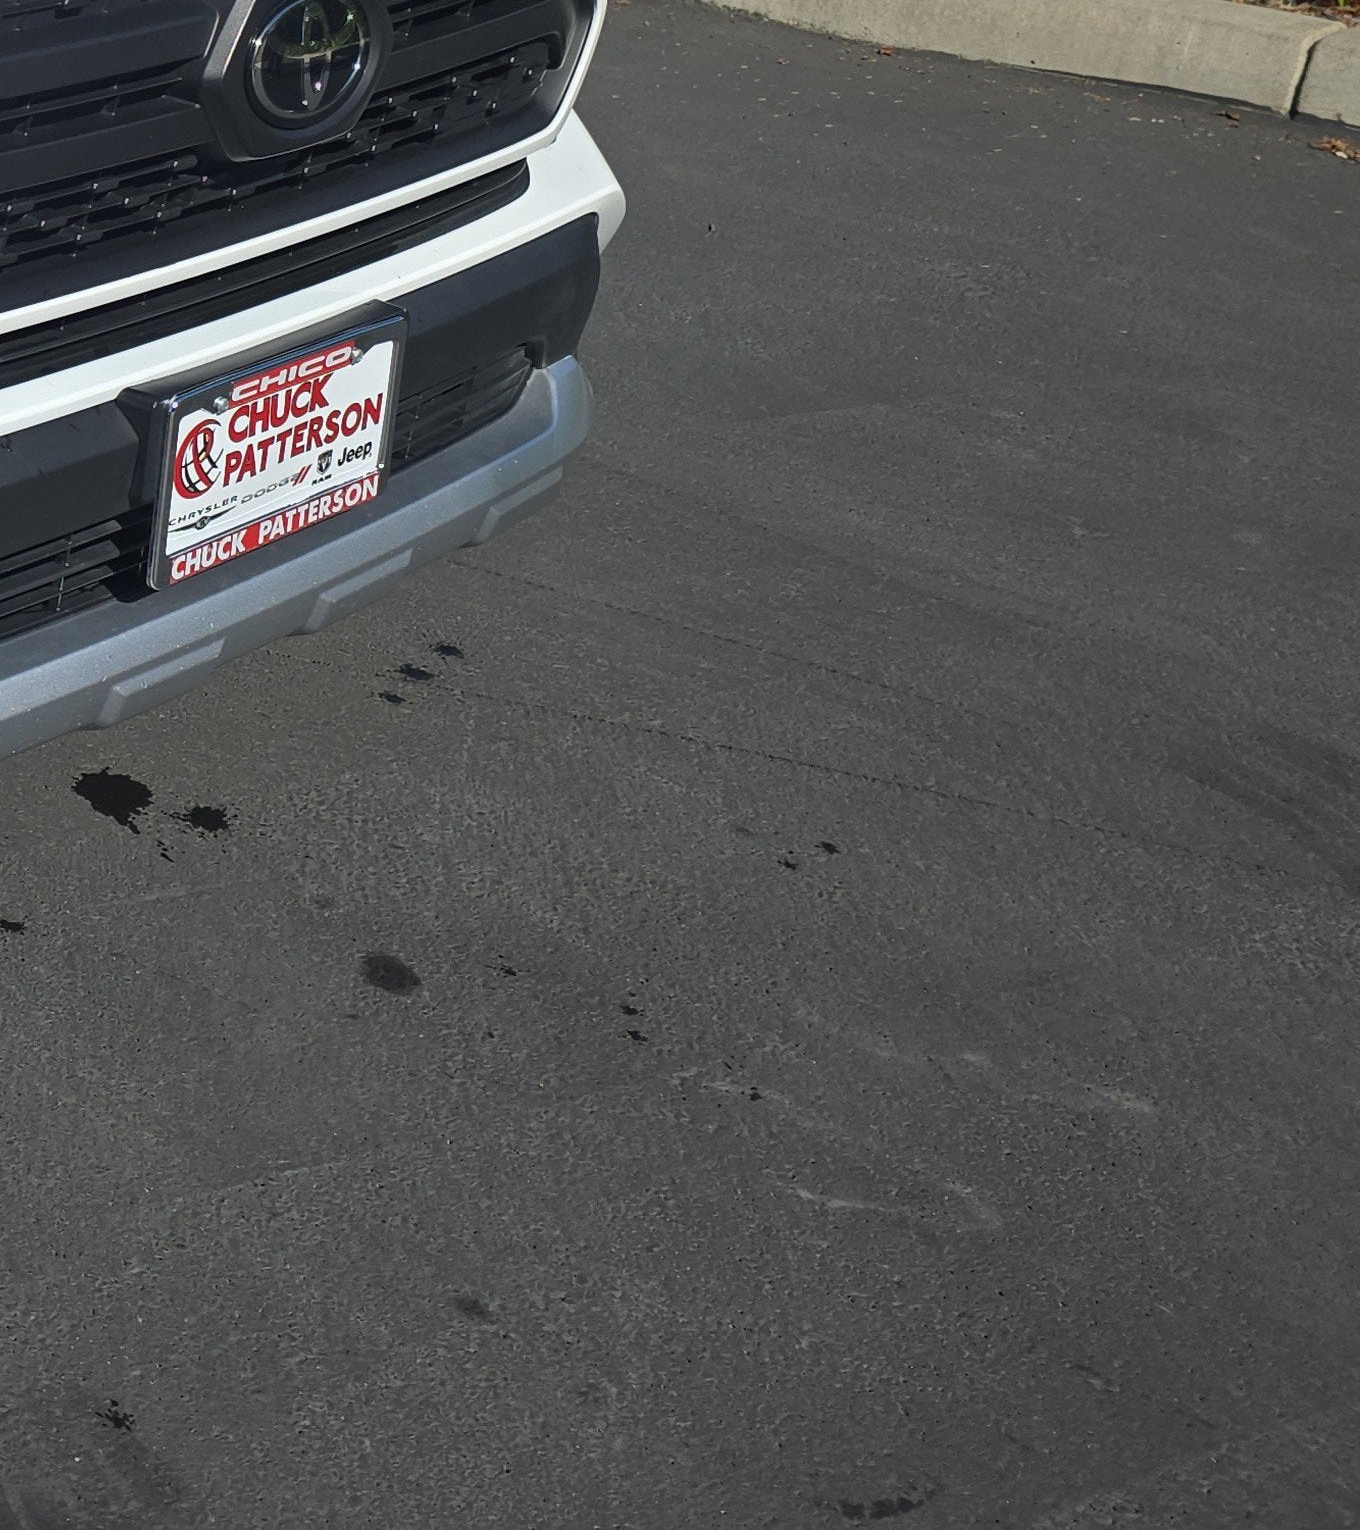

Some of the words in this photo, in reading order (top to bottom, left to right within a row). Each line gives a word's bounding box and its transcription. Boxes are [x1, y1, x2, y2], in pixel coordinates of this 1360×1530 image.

[229, 372, 334, 443] CHUCK
[232, 347, 351, 402] CHICO
[223, 393, 383, 488] PATTERSON
[168, 495, 238, 526] CHRYSLER
[312, 474, 332, 486] RAM
[338, 441, 372, 466] Jeep
[171, 529, 247, 580] CHUCK
[258, 475, 379, 545] PATTERSON
